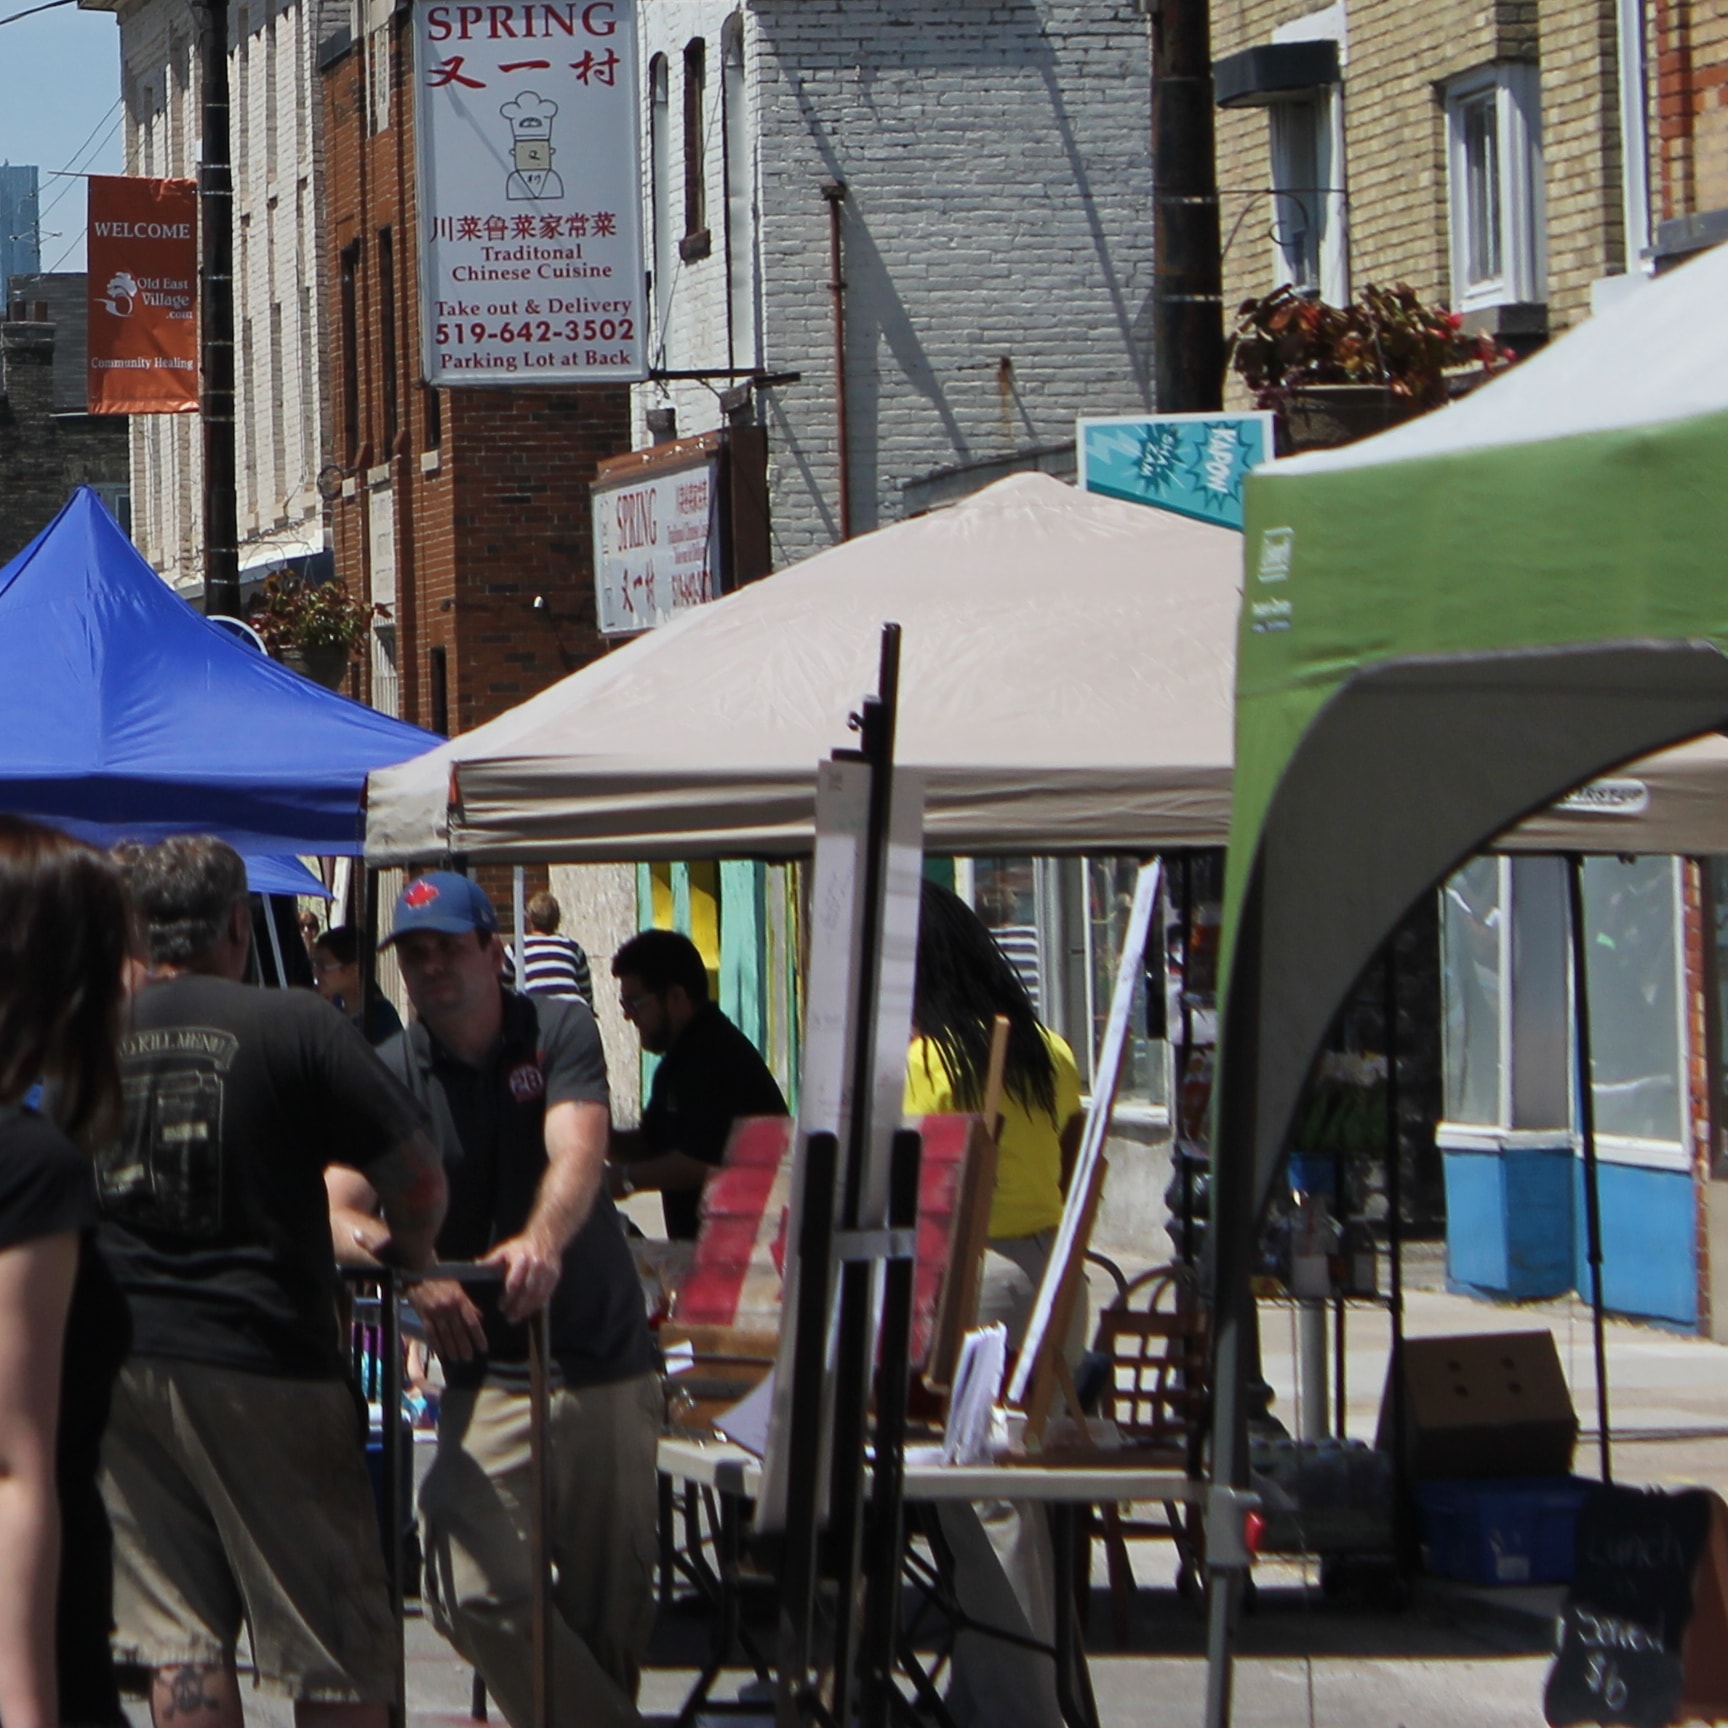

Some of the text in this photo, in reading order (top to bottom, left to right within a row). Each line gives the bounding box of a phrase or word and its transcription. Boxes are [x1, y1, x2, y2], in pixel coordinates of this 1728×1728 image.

[426, 1, 618, 42] SPRING
[425, 47, 621, 89] 又一村
[94, 221, 191, 239] WELCOME
[452, 262, 613, 282] Chinese Cuisine
[137, 277, 189, 290] Old East
[141, 292, 190, 309] Village
[435, 297, 632, 317] Take out & Delivery
[435, 319, 634, 345] 519-642-3502
[91, 357, 194, 371] Community Healing
[441, 349, 632, 372] Parking Lot at Back
[1205, 427, 1238, 494] KAPOW
[616, 487, 658, 551] SPRING
